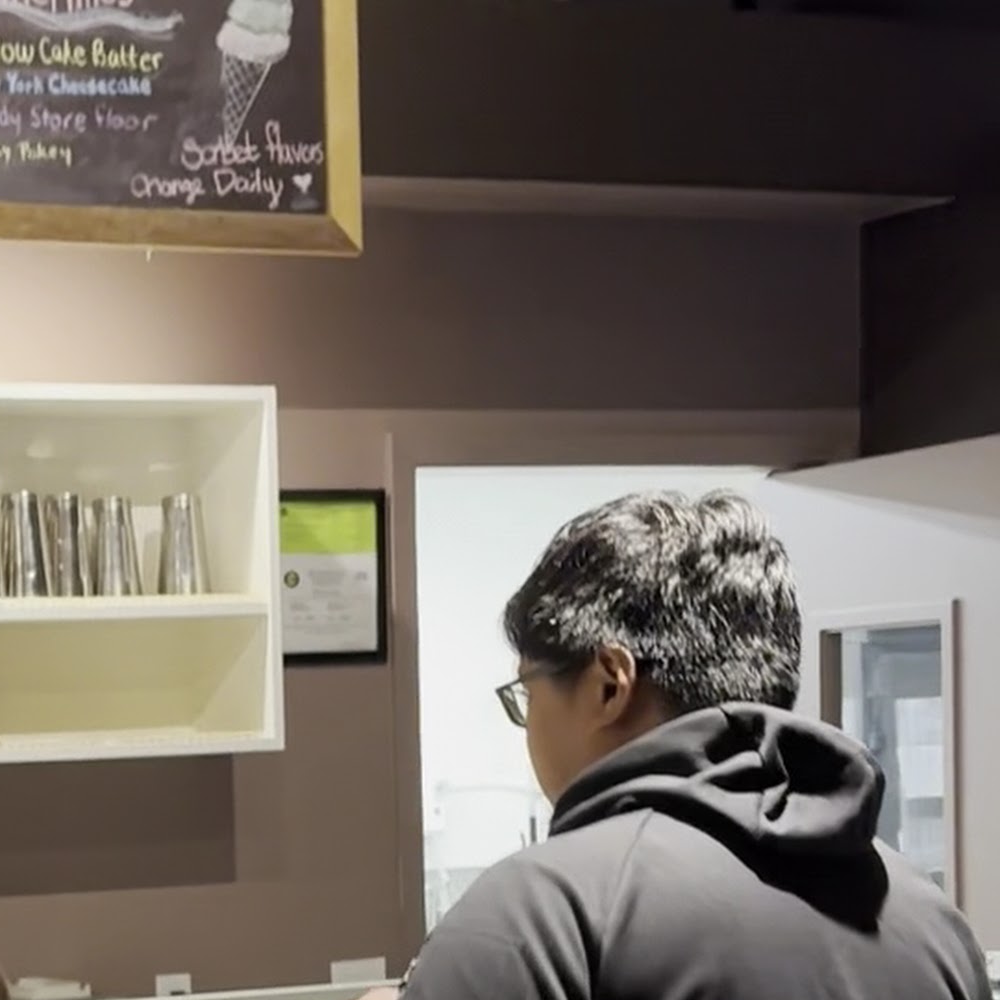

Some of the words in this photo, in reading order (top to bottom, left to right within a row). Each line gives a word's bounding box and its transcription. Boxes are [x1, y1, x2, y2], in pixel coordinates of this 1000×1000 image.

[39, 36, 87, 67] Cake
[92, 38, 164, 72] Batter
[7, 71, 44, 94] York
[49, 73, 152, 96] Cheesecake
[30, 104, 86, 133] Store
[214, 167, 284, 210] Daily
